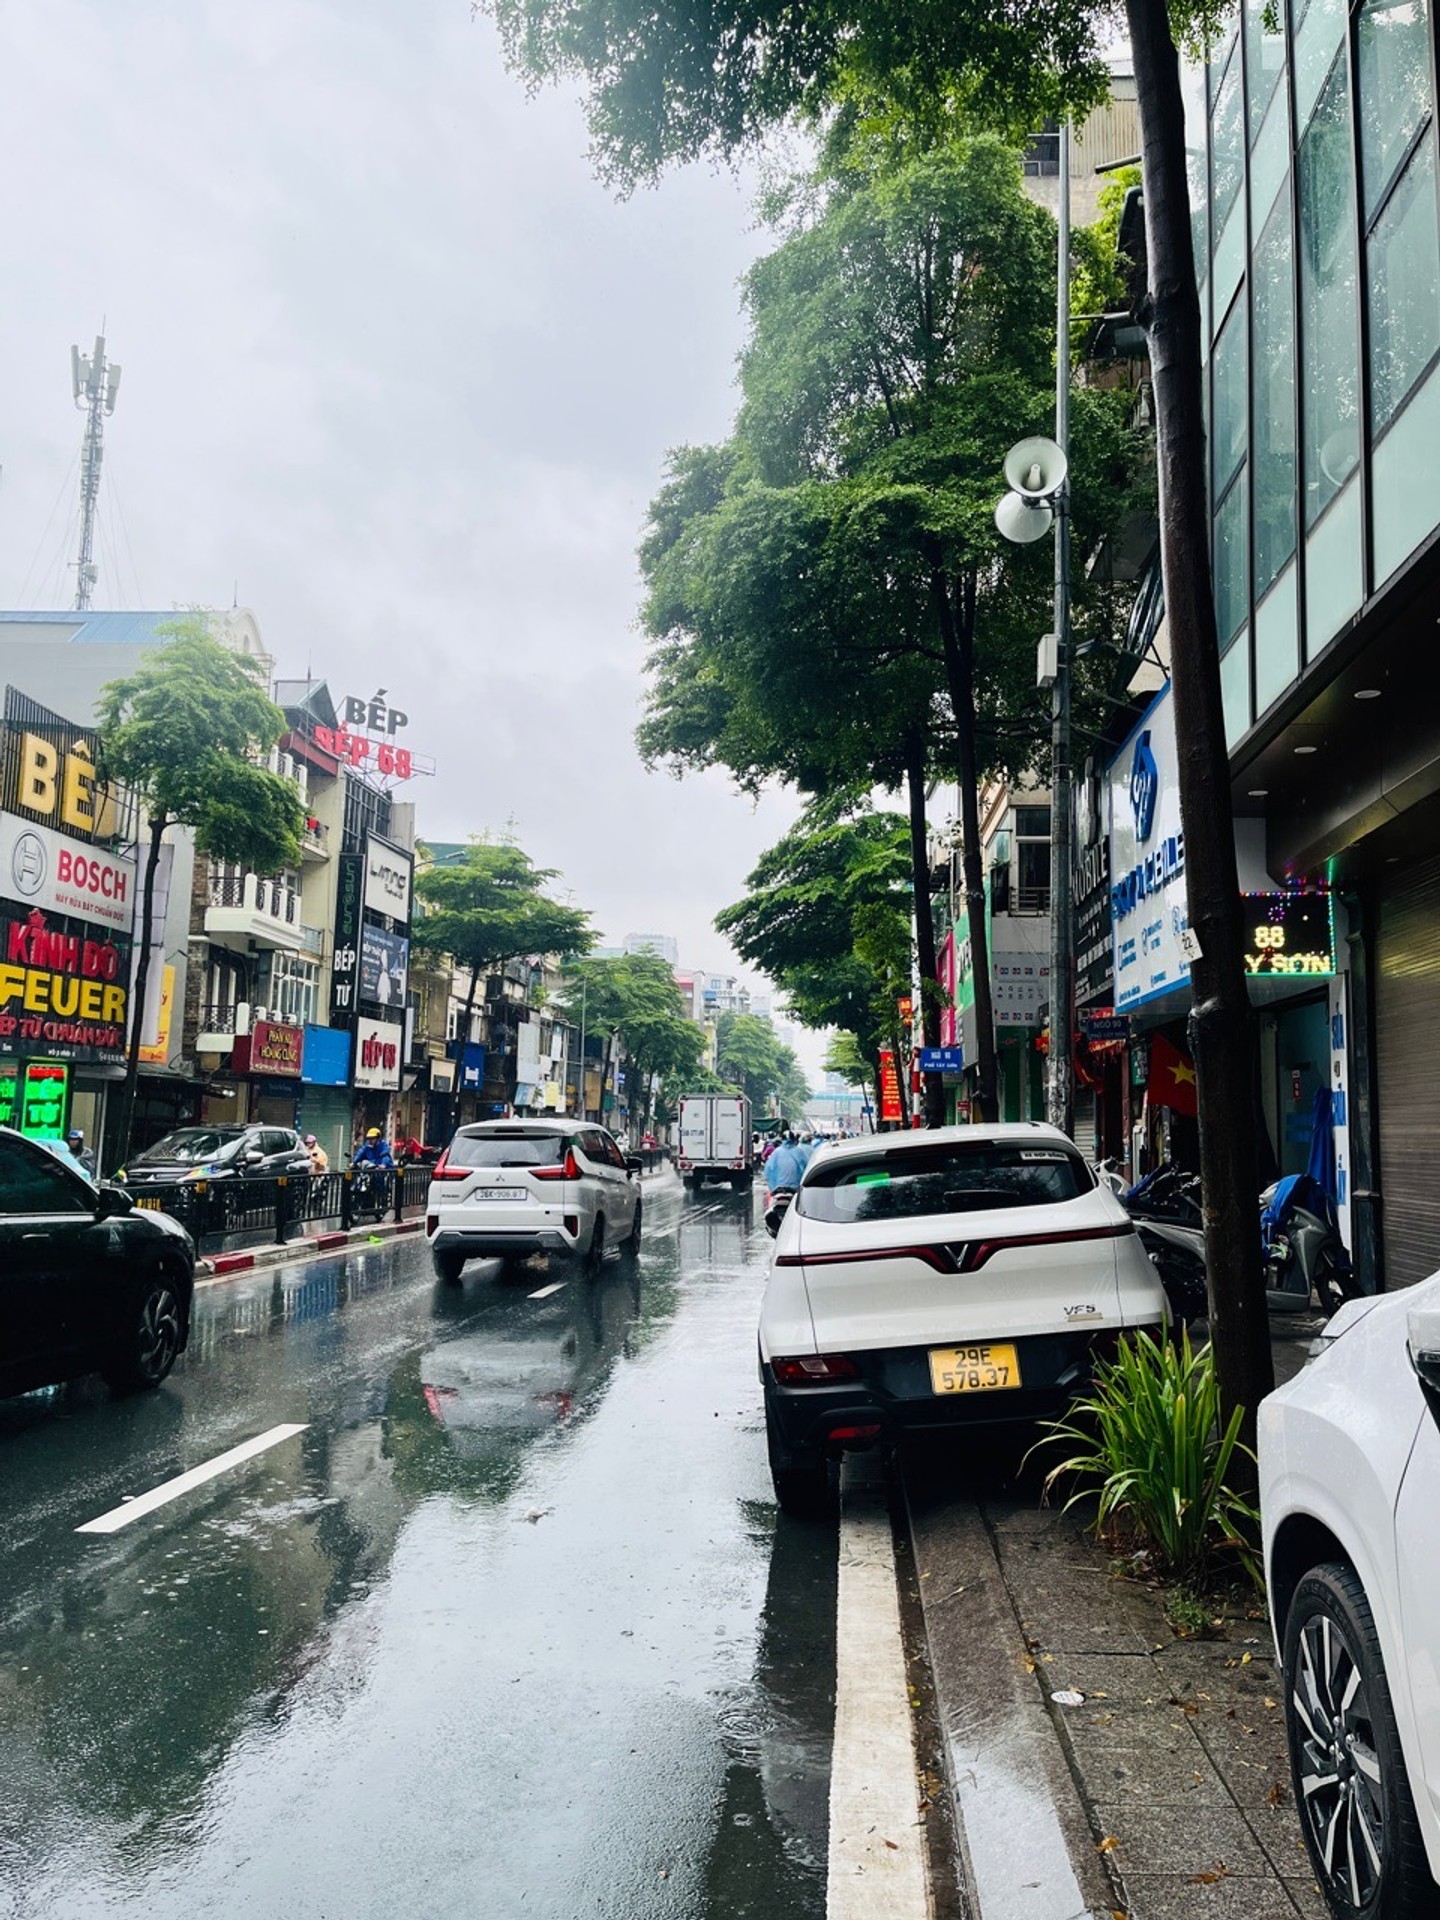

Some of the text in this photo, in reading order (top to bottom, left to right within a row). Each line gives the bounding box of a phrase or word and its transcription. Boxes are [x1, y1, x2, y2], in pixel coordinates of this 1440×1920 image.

[345, 688, 409, 735] BẾP
[378, 743, 412, 780] 68
[57, 848, 128, 903] BOSCH
[81, 938, 119, 980] ĐÔ
[334, 942, 356, 972] BẾP
[0, 962, 127, 1023] FEUER
[335, 979, 352, 1007] TỪ
[20, 1014, 44, 1038] TỪ
[362, 1032, 382, 1069] BẾP
[954, 1348, 994, 1368] 29E
[942, 1367, 1010, 1391] 578.37
